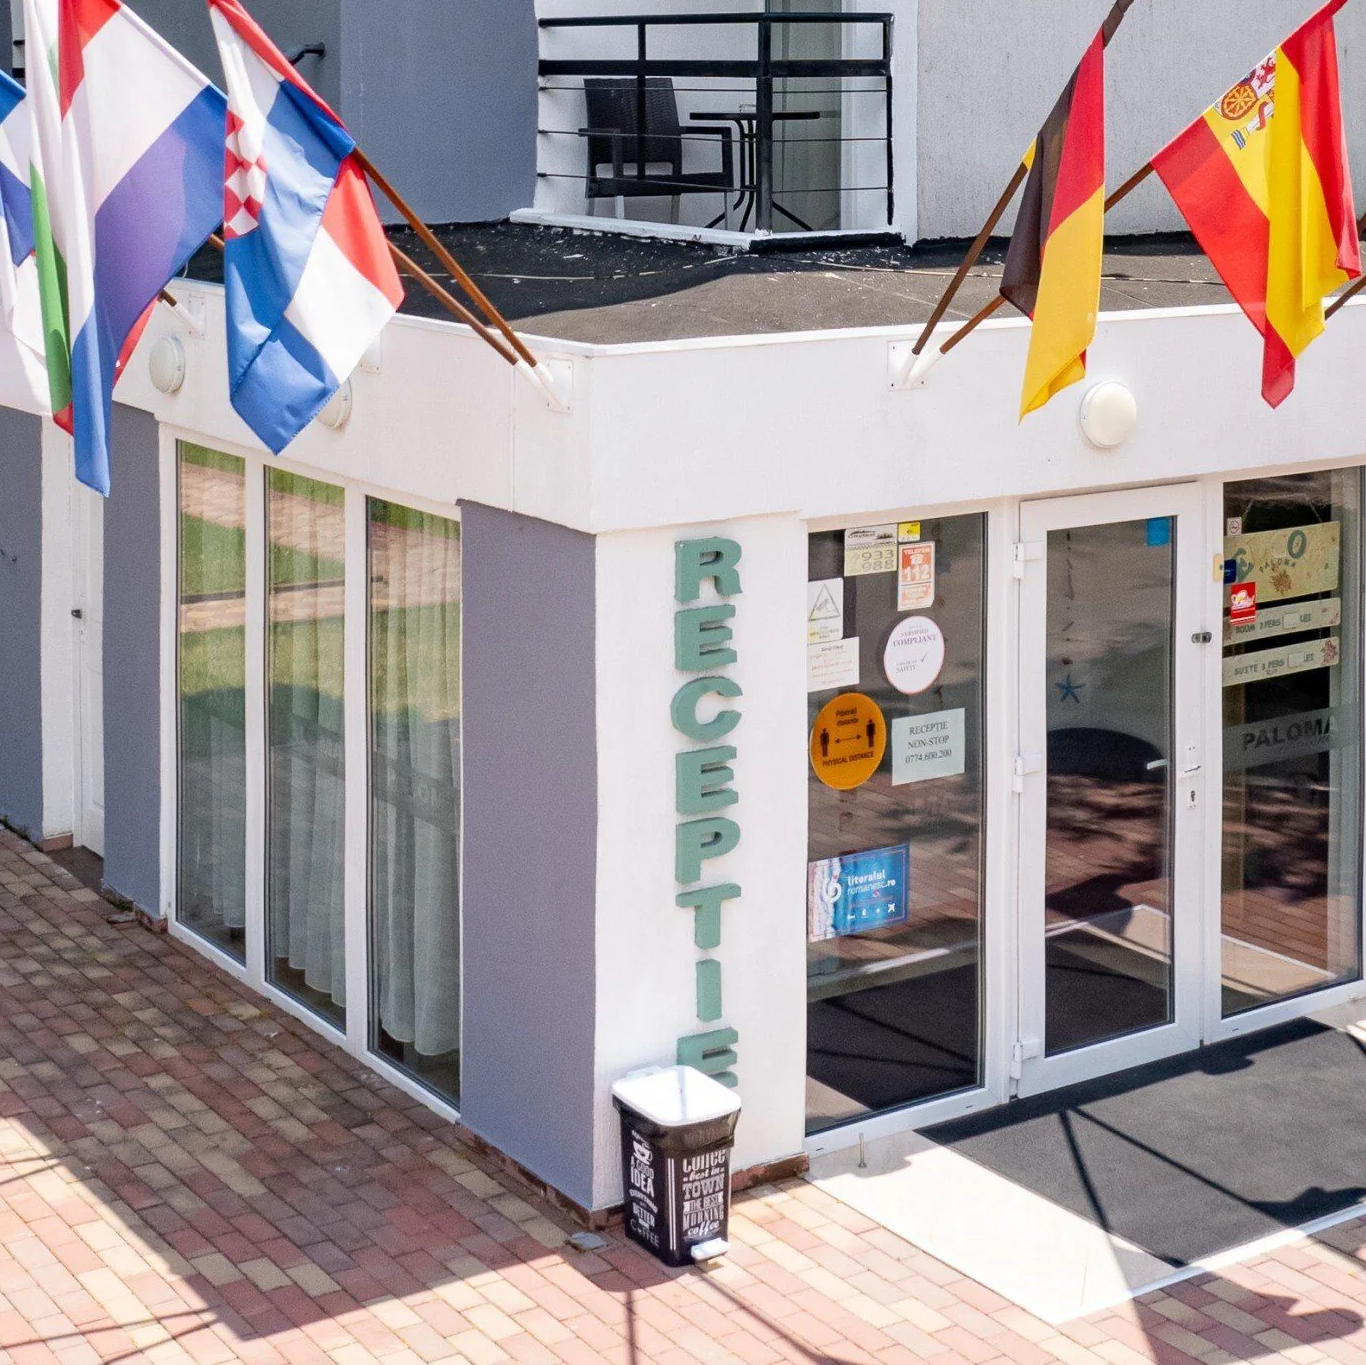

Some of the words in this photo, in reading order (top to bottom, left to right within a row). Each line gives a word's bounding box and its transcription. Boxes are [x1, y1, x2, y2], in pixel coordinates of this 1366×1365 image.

[904, 565, 931, 582] 112
[892, 634, 936, 648] COMPLIANT
[907, 734, 950, 749] NON-STOP
[822, 756, 848, 766] PHYSICAL
[849, 750, 874, 762] DISTANCE
[670, 535, 744, 1089] RECEPTIE
[847, 868, 886, 887] litoralul
[631, 1166, 655, 1198] IDEA
[682, 1172, 725, 1201] TOWN
[682, 1204, 725, 1232] MORNING
[687, 1220, 721, 1237] coffee
